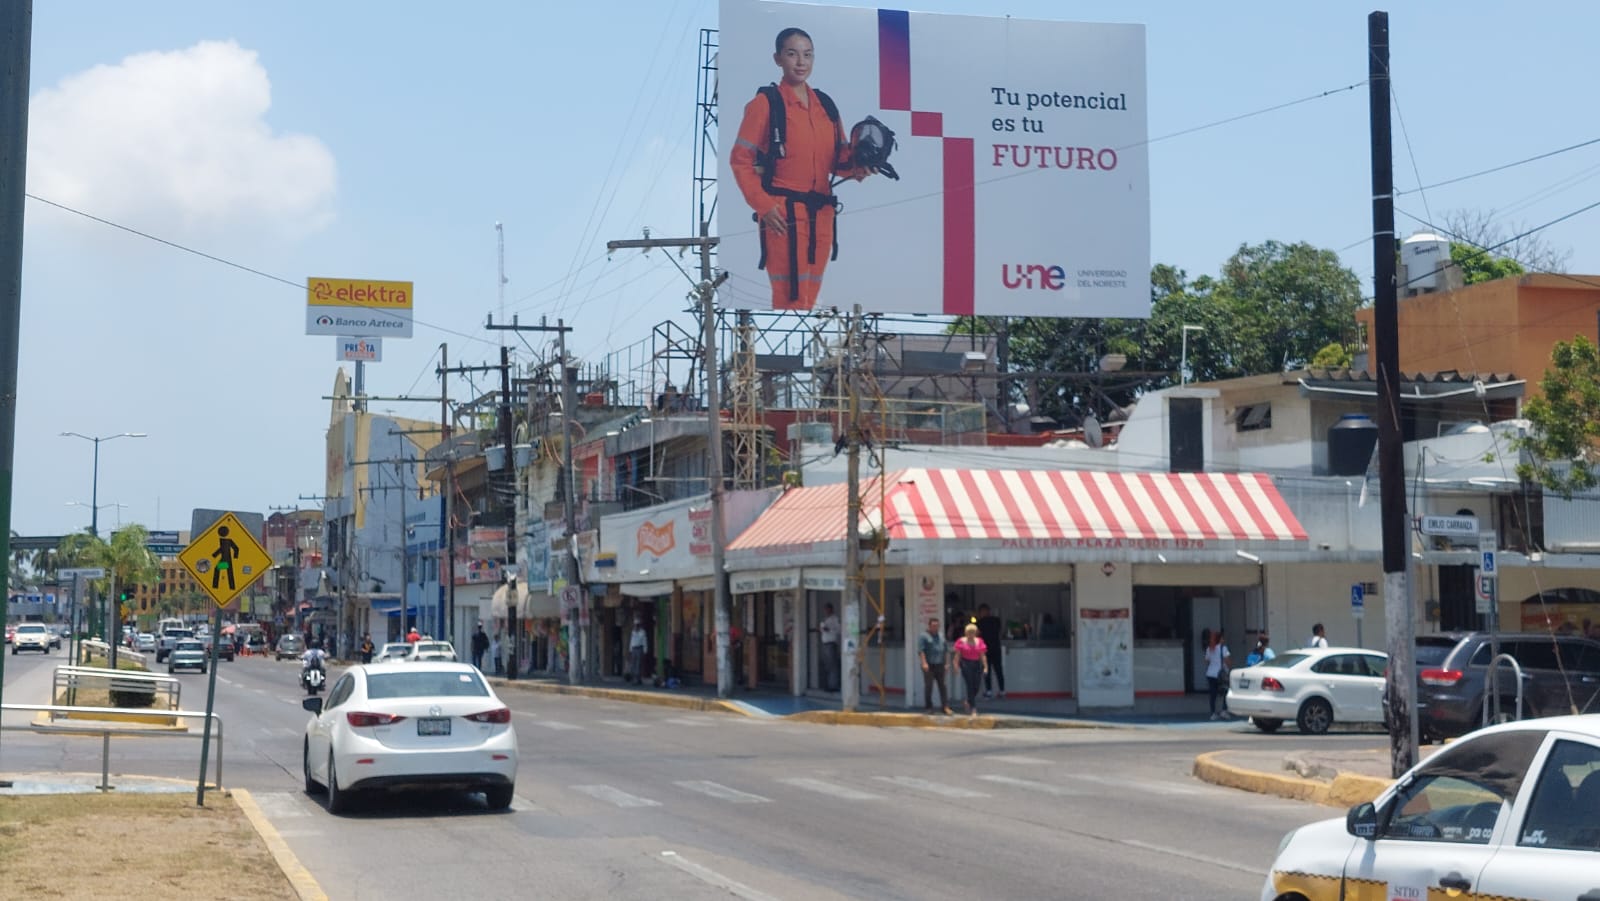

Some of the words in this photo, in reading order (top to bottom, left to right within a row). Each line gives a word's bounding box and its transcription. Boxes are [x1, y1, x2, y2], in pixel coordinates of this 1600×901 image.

[991, 87, 1020, 105] Tu
[1026, 91, 1126, 111] potencial
[991, 117, 1015, 132] es
[1022, 116, 1044, 133] tu
[992, 144, 1118, 171] FUTURO
[1002, 264, 1066, 291] une
[1077, 270, 1127, 278] UNIVERSIDAD
[1077, 280, 1092, 288] DEL
[1094, 281, 1127, 289] NORESTE
[335, 283, 407, 304] elektra
[335, 317, 367, 327] Banco
[368, 318, 404, 329] Azteca
[1428, 519, 1444, 530] EMILIO
[1446, 519, 1473, 531] CARRANZA
[1001, 538, 1073, 549] PALETERIA
[1077, 538, 1122, 548] PLAZA
[1128, 538, 1169, 549] DESDE
[1393, 885, 1420, 898] SITIO
